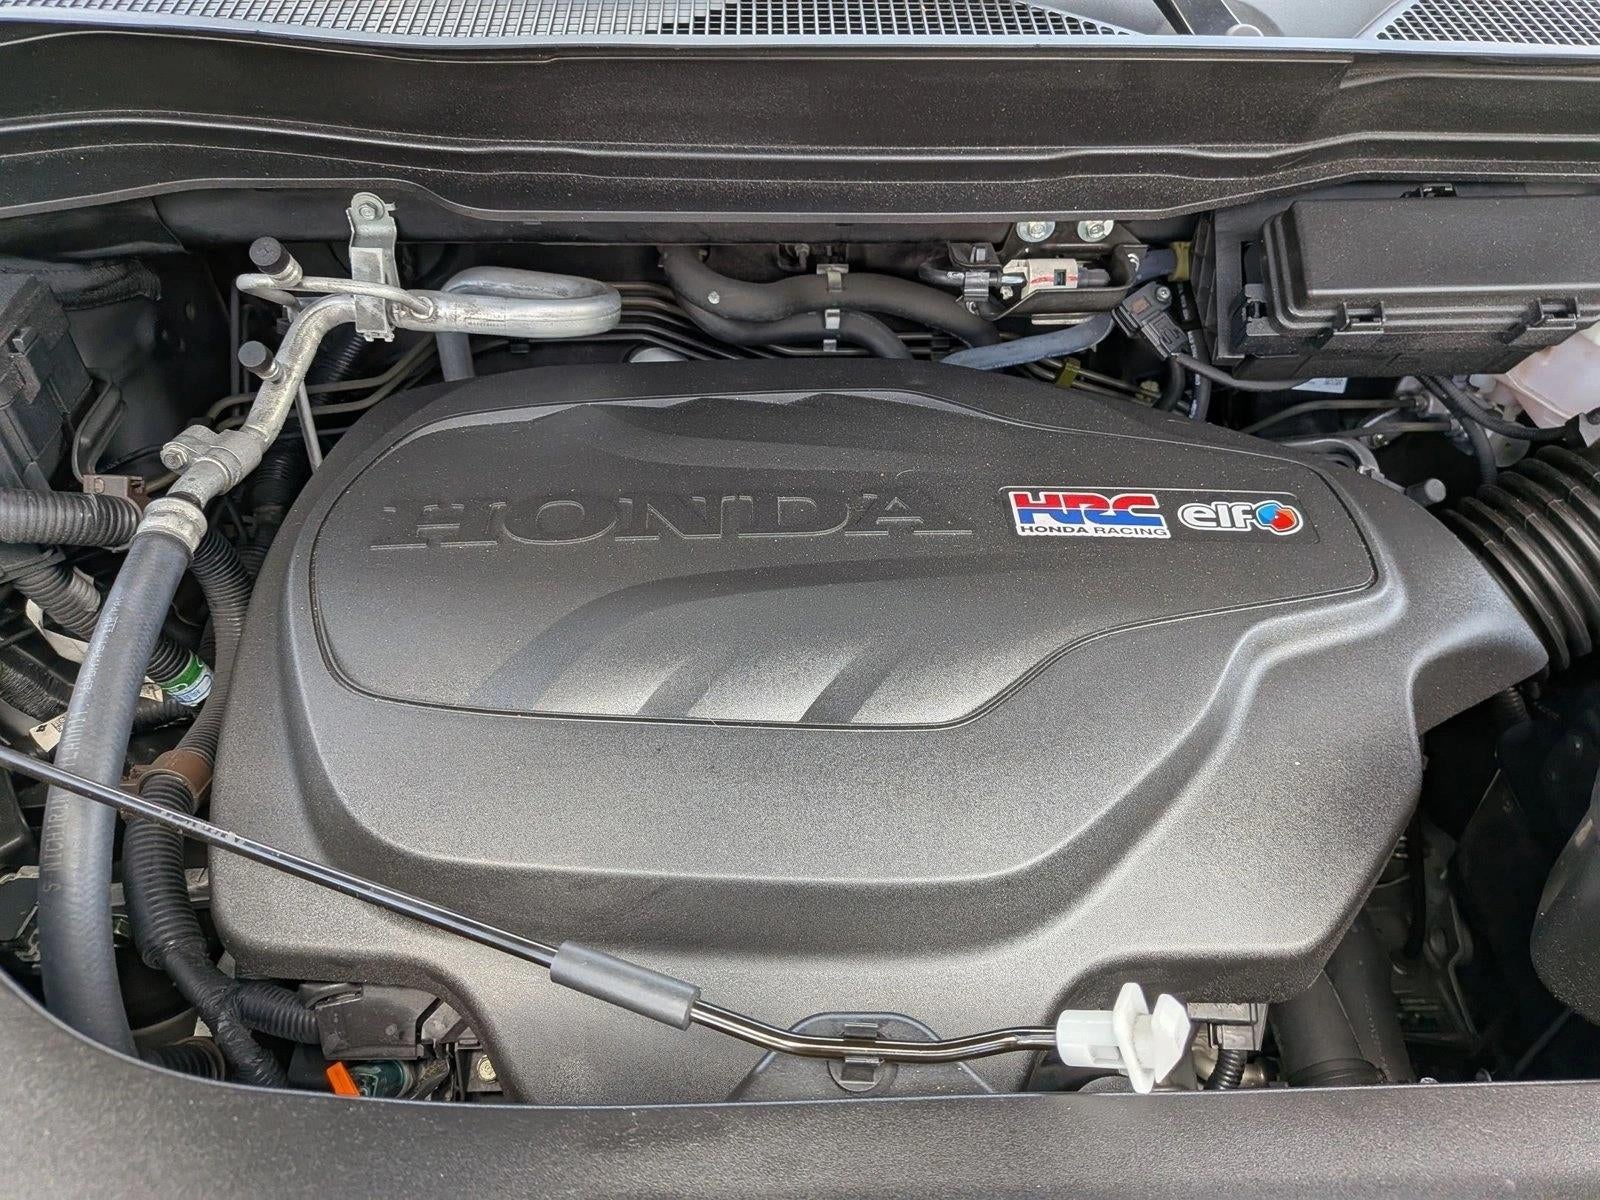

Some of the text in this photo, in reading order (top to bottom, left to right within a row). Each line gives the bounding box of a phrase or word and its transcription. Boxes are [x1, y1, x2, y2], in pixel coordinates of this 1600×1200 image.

[370, 493, 973, 551] HONDA
[1013, 493, 1164, 527] HRC
[1180, 502, 1255, 530] elf
[1020, 525, 1168, 537] HONDA RACING
